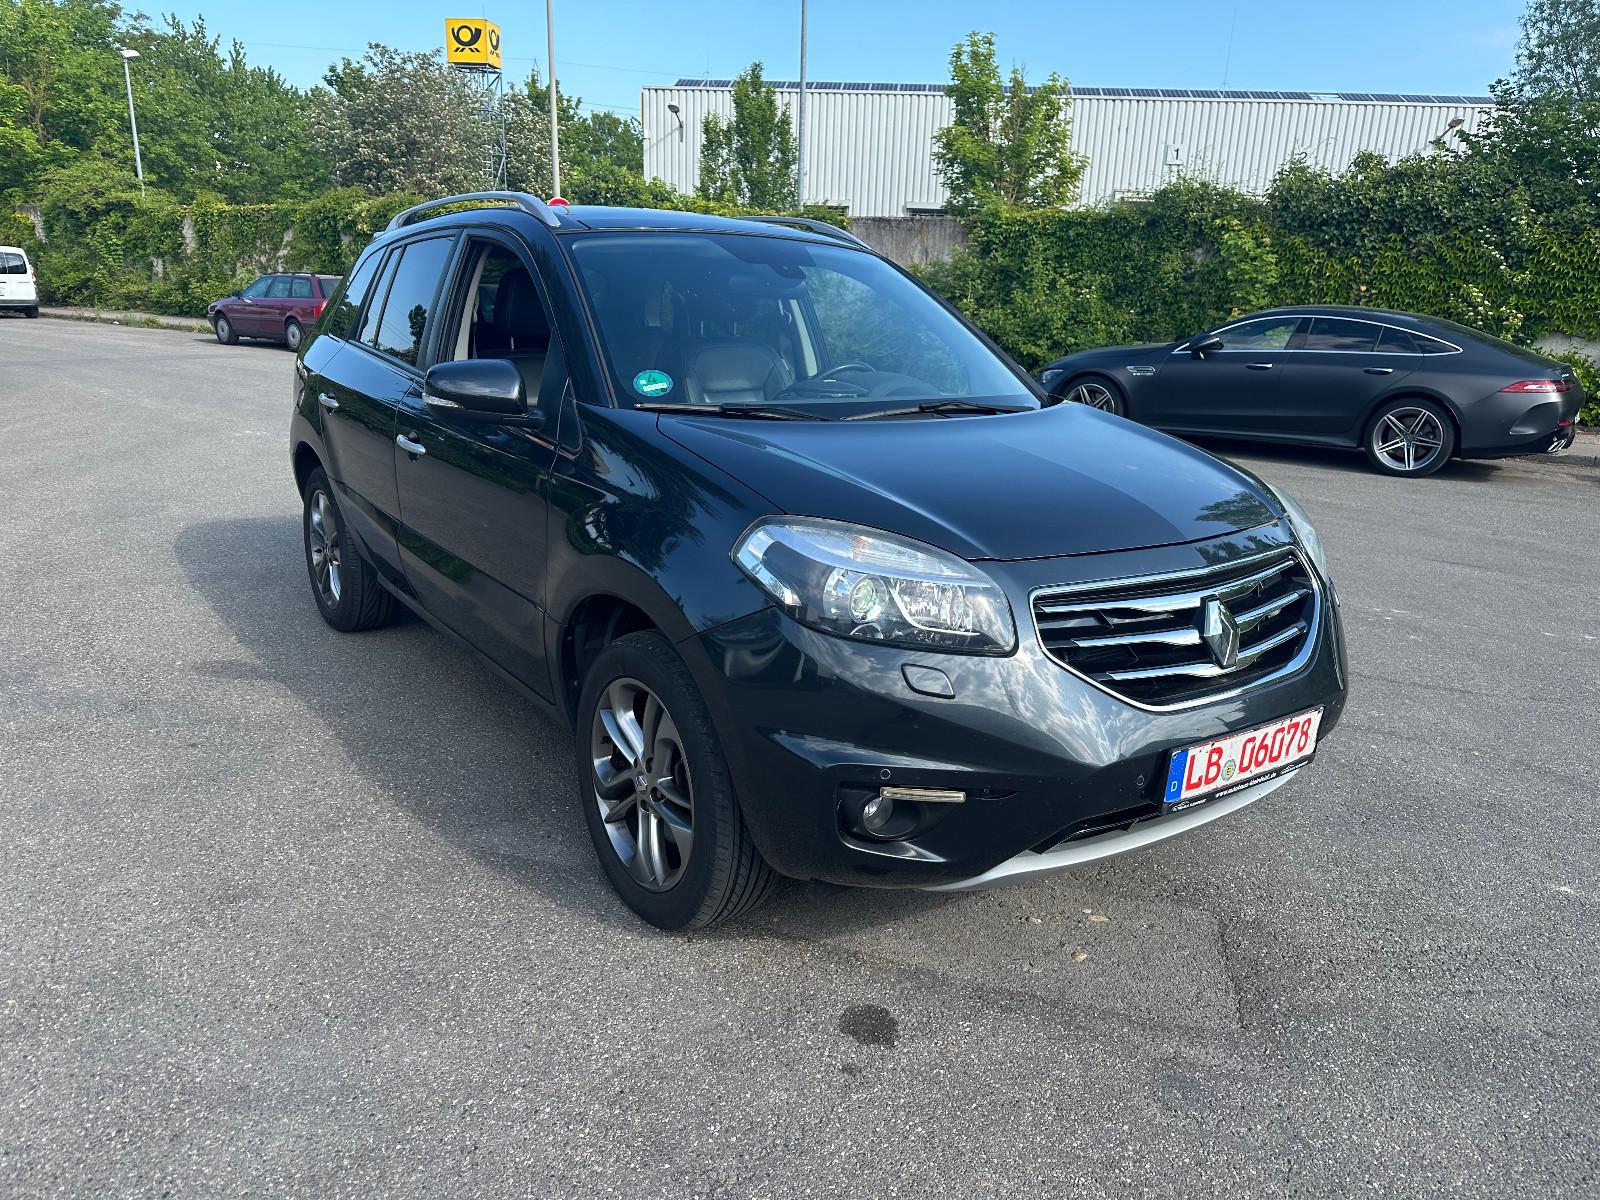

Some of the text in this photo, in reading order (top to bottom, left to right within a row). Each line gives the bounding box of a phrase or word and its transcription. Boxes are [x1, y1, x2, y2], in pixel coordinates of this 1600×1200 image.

[1185, 717, 1312, 791] LB 06078
[1170, 781, 1178, 792] D
